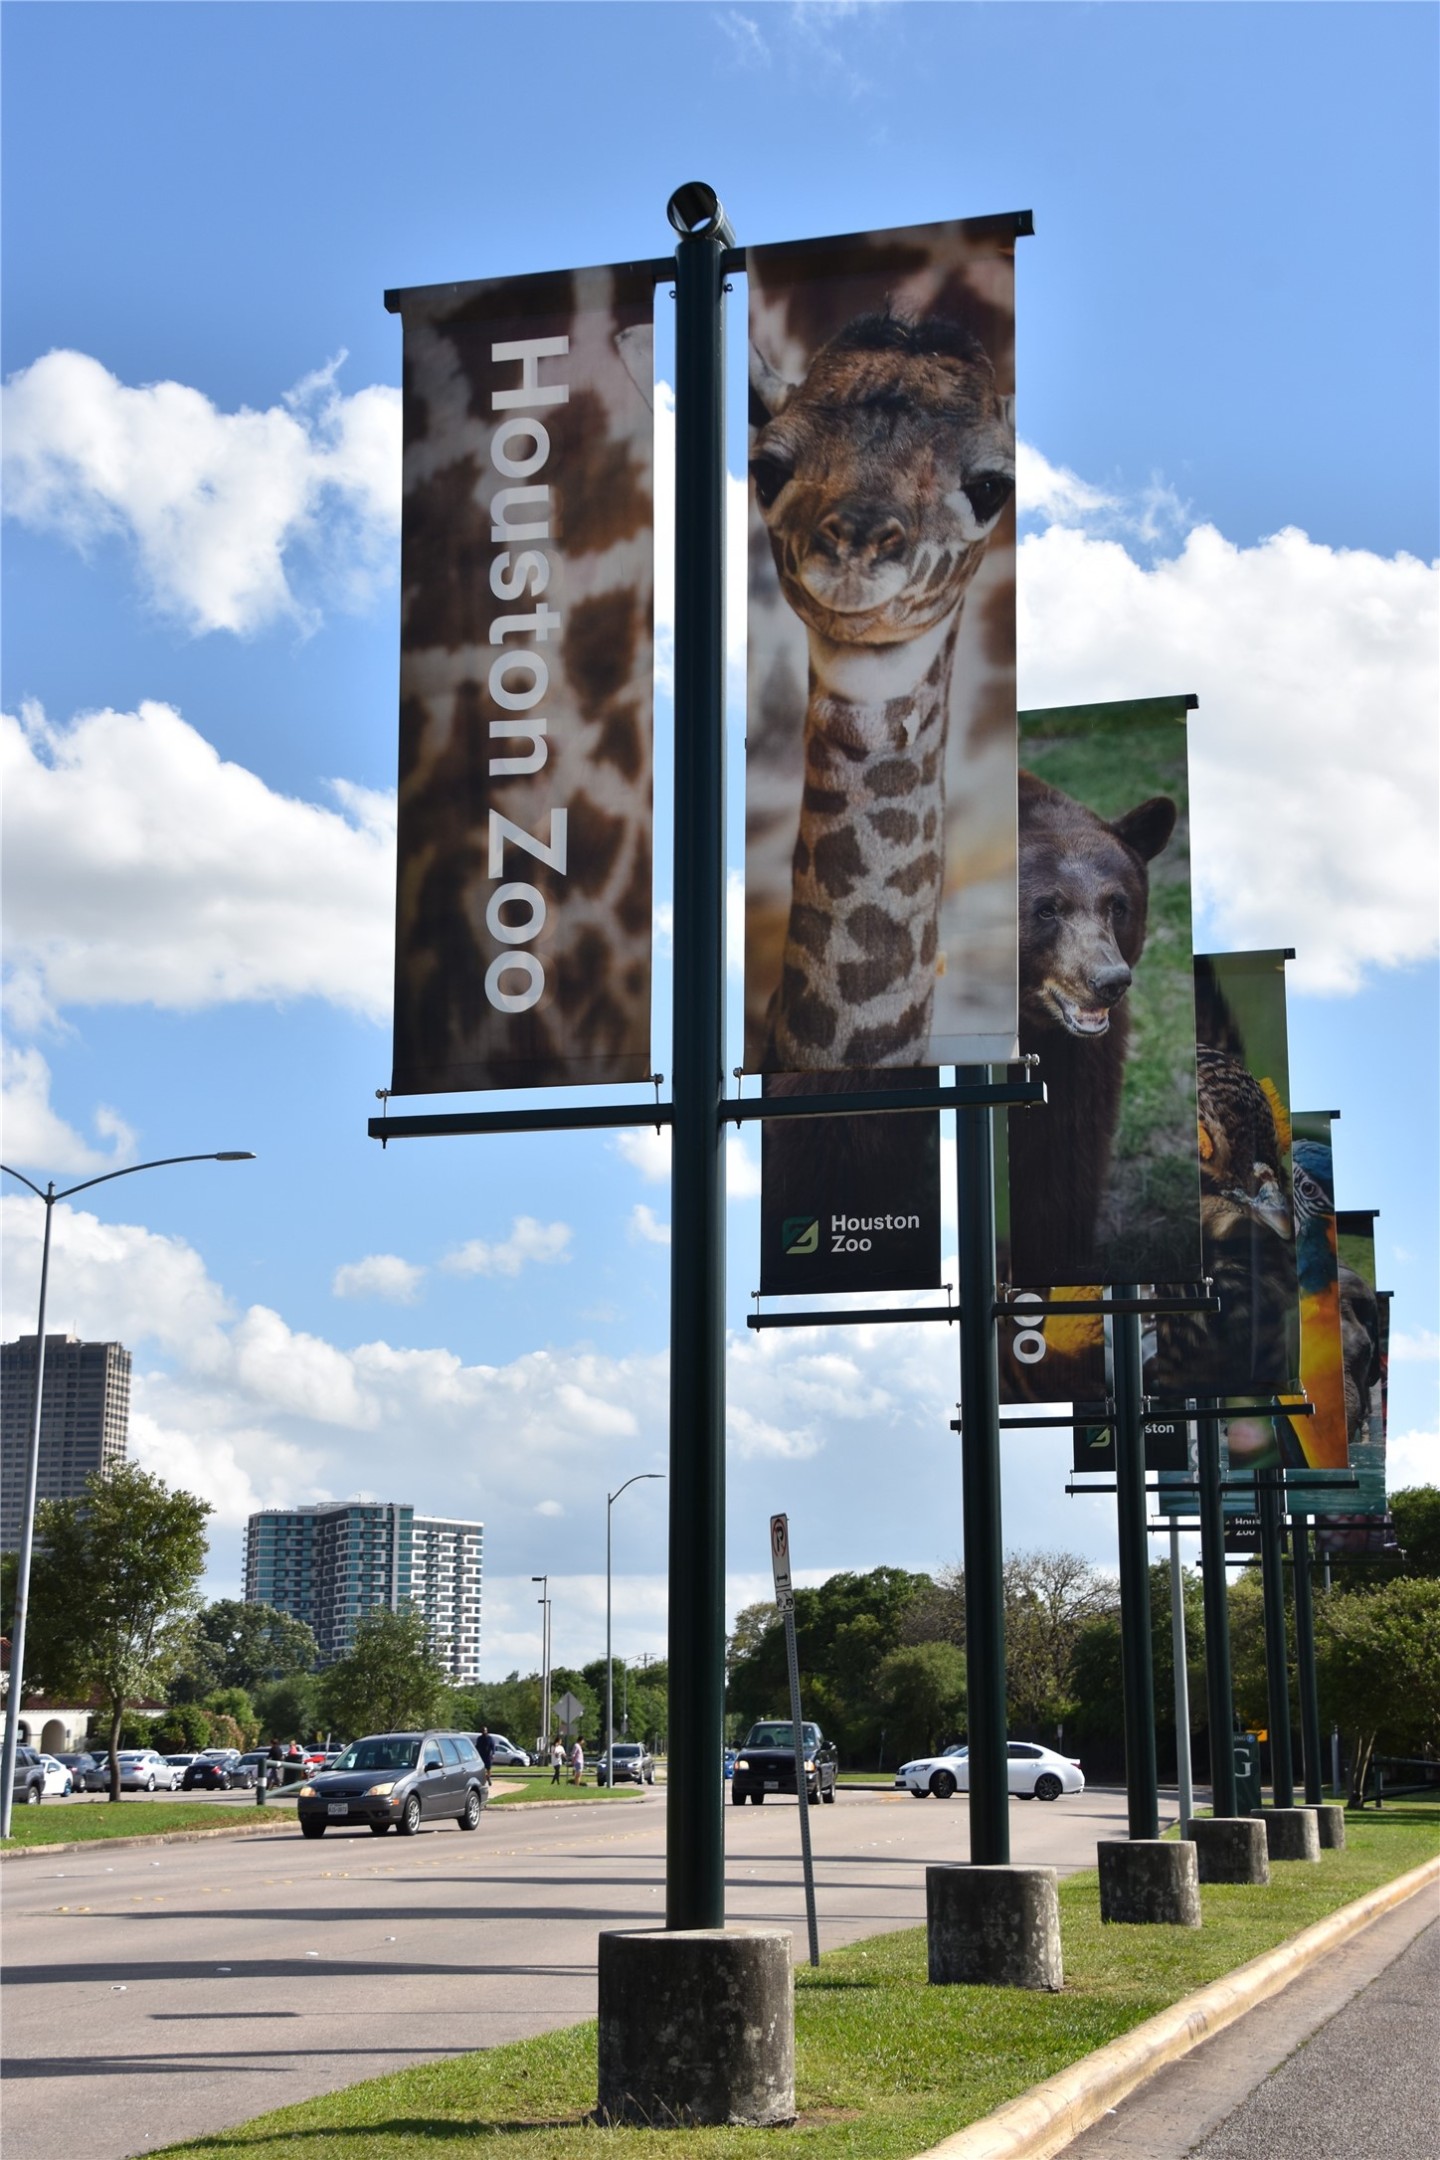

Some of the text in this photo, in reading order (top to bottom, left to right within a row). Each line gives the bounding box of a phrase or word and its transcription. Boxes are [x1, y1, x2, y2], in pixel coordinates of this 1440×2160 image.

[485, 335, 569, 1013] Houston Zoo
[831, 1214, 920, 1231] Houston
[831, 1235, 872, 1252] Zoo
[1013, 1293, 1046, 1364] oo
[1145, 1423, 1175, 1433] ston
